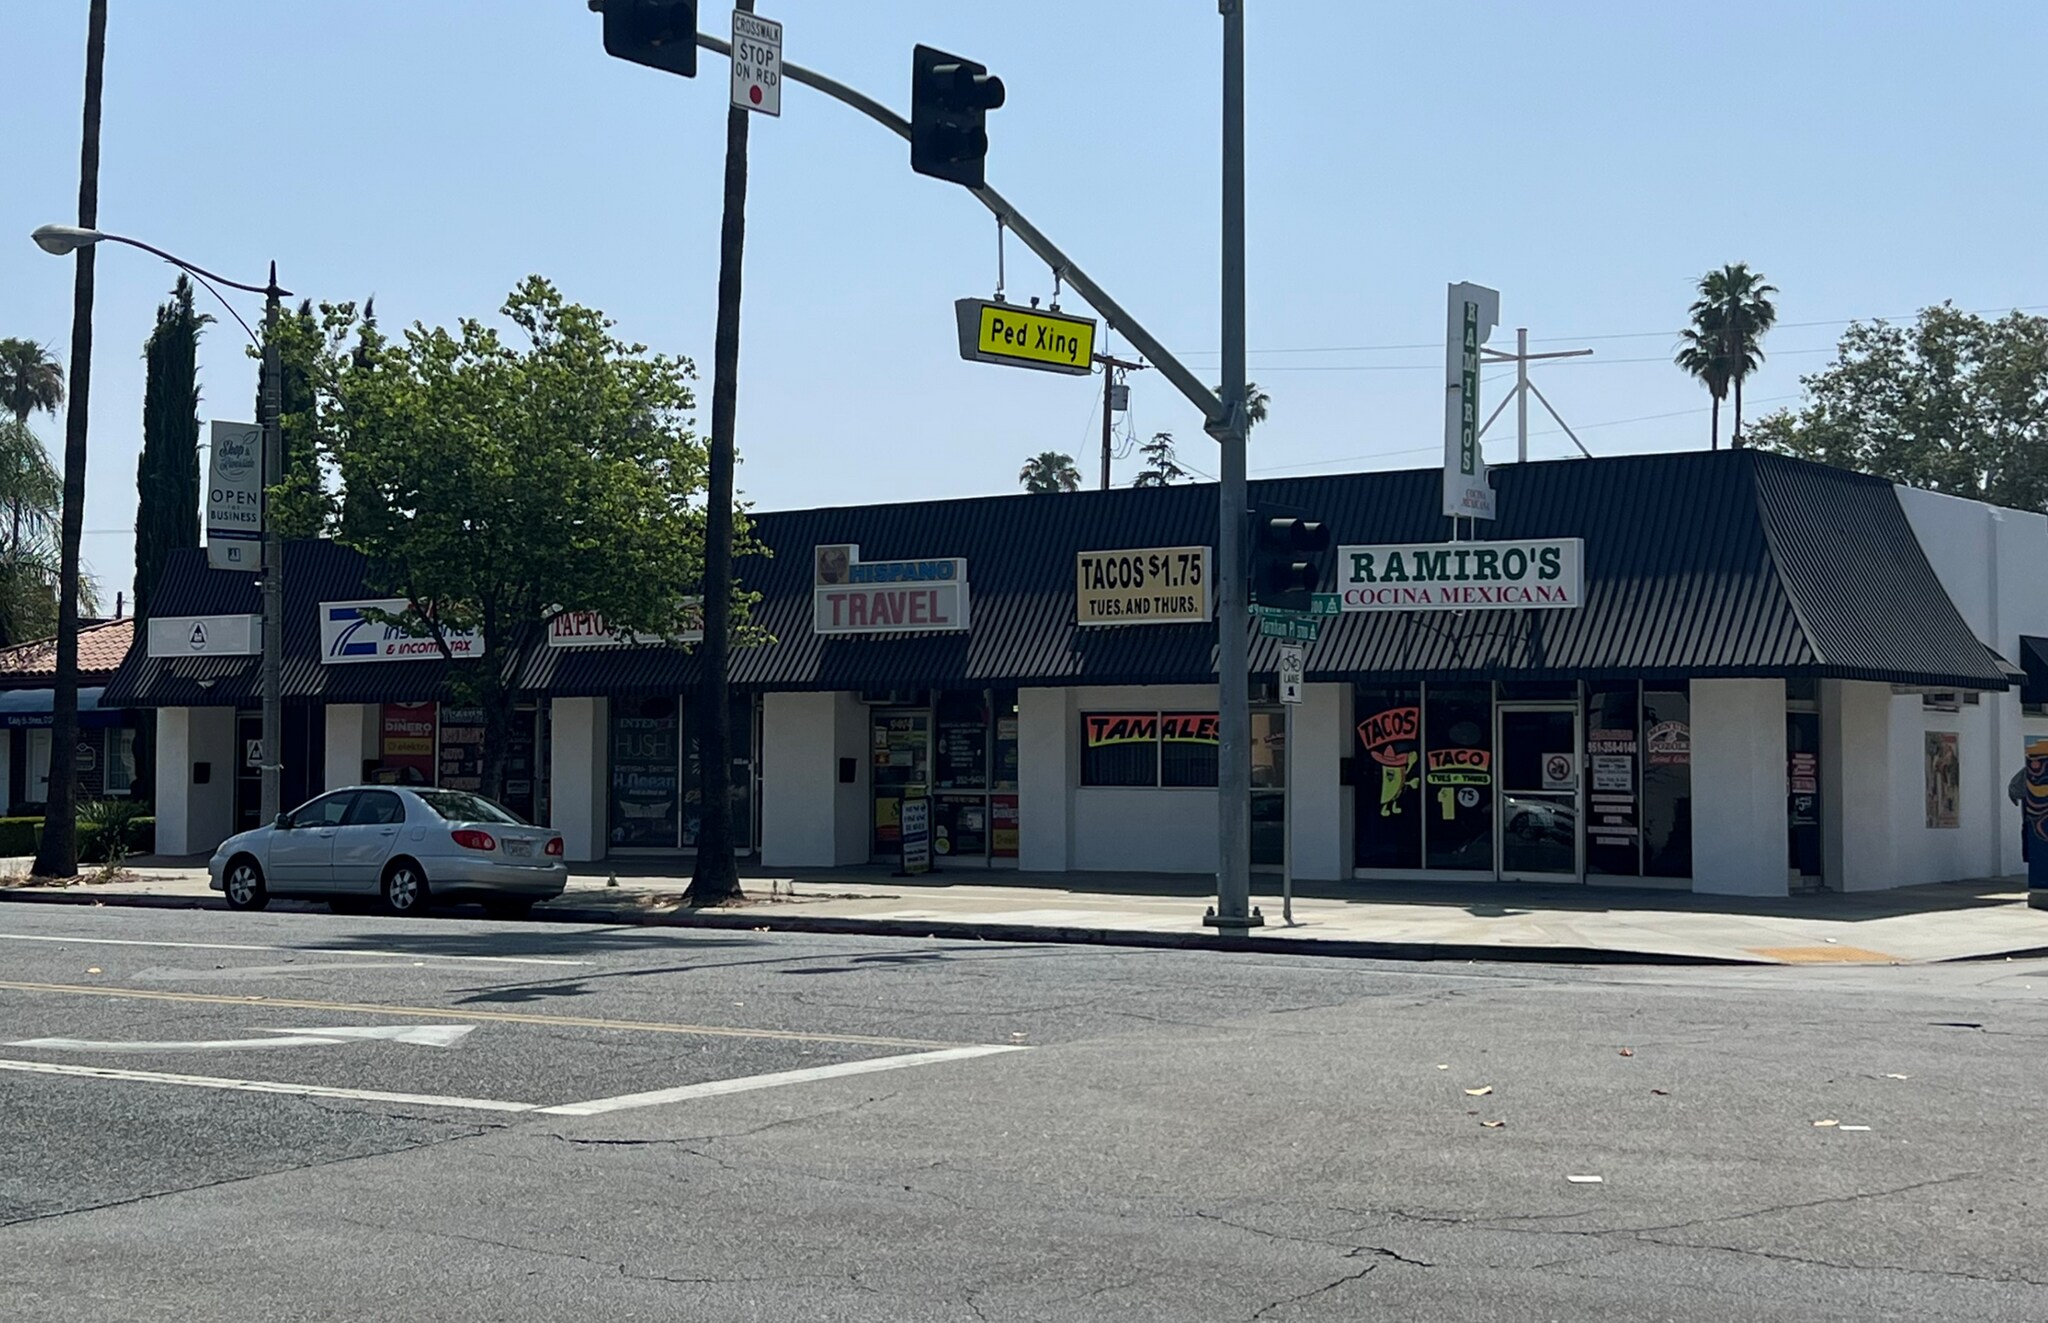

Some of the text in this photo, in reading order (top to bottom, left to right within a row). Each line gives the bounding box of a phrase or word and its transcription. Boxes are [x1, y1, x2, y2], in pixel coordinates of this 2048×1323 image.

[735, 15, 779, 41] CROSSWALK
[740, 42, 774, 67] STOP
[735, 62, 777, 86] ON RED
[991, 318, 1078, 362] Ped Xing
[1462, 302, 1477, 471] RAMIRO'S
[211, 489, 257, 505] OPEN
[210, 510, 257, 523] BUSINESS
[851, 560, 954, 583] HISPANO
[1081, 553, 1201, 590] TACOS $1.75
[1350, 547, 1561, 583] RAMIRO'S
[1089, 595, 1198, 615] TUES. AND THURS.
[1344, 585, 1568, 605] COCINA MEXICANA
[826, 590, 948, 626] TRAVEL
[386, 640, 473, 655] & INCOM TAX
[1283, 673, 1300, 684] LANE
[385, 722, 432, 732] DINERO
[1360, 710, 1417, 747] TACOS
[1650, 722, 1690, 738] MENUD
[1430, 750, 1484, 767] TACO
[1461, 790, 1475, 801] 75
